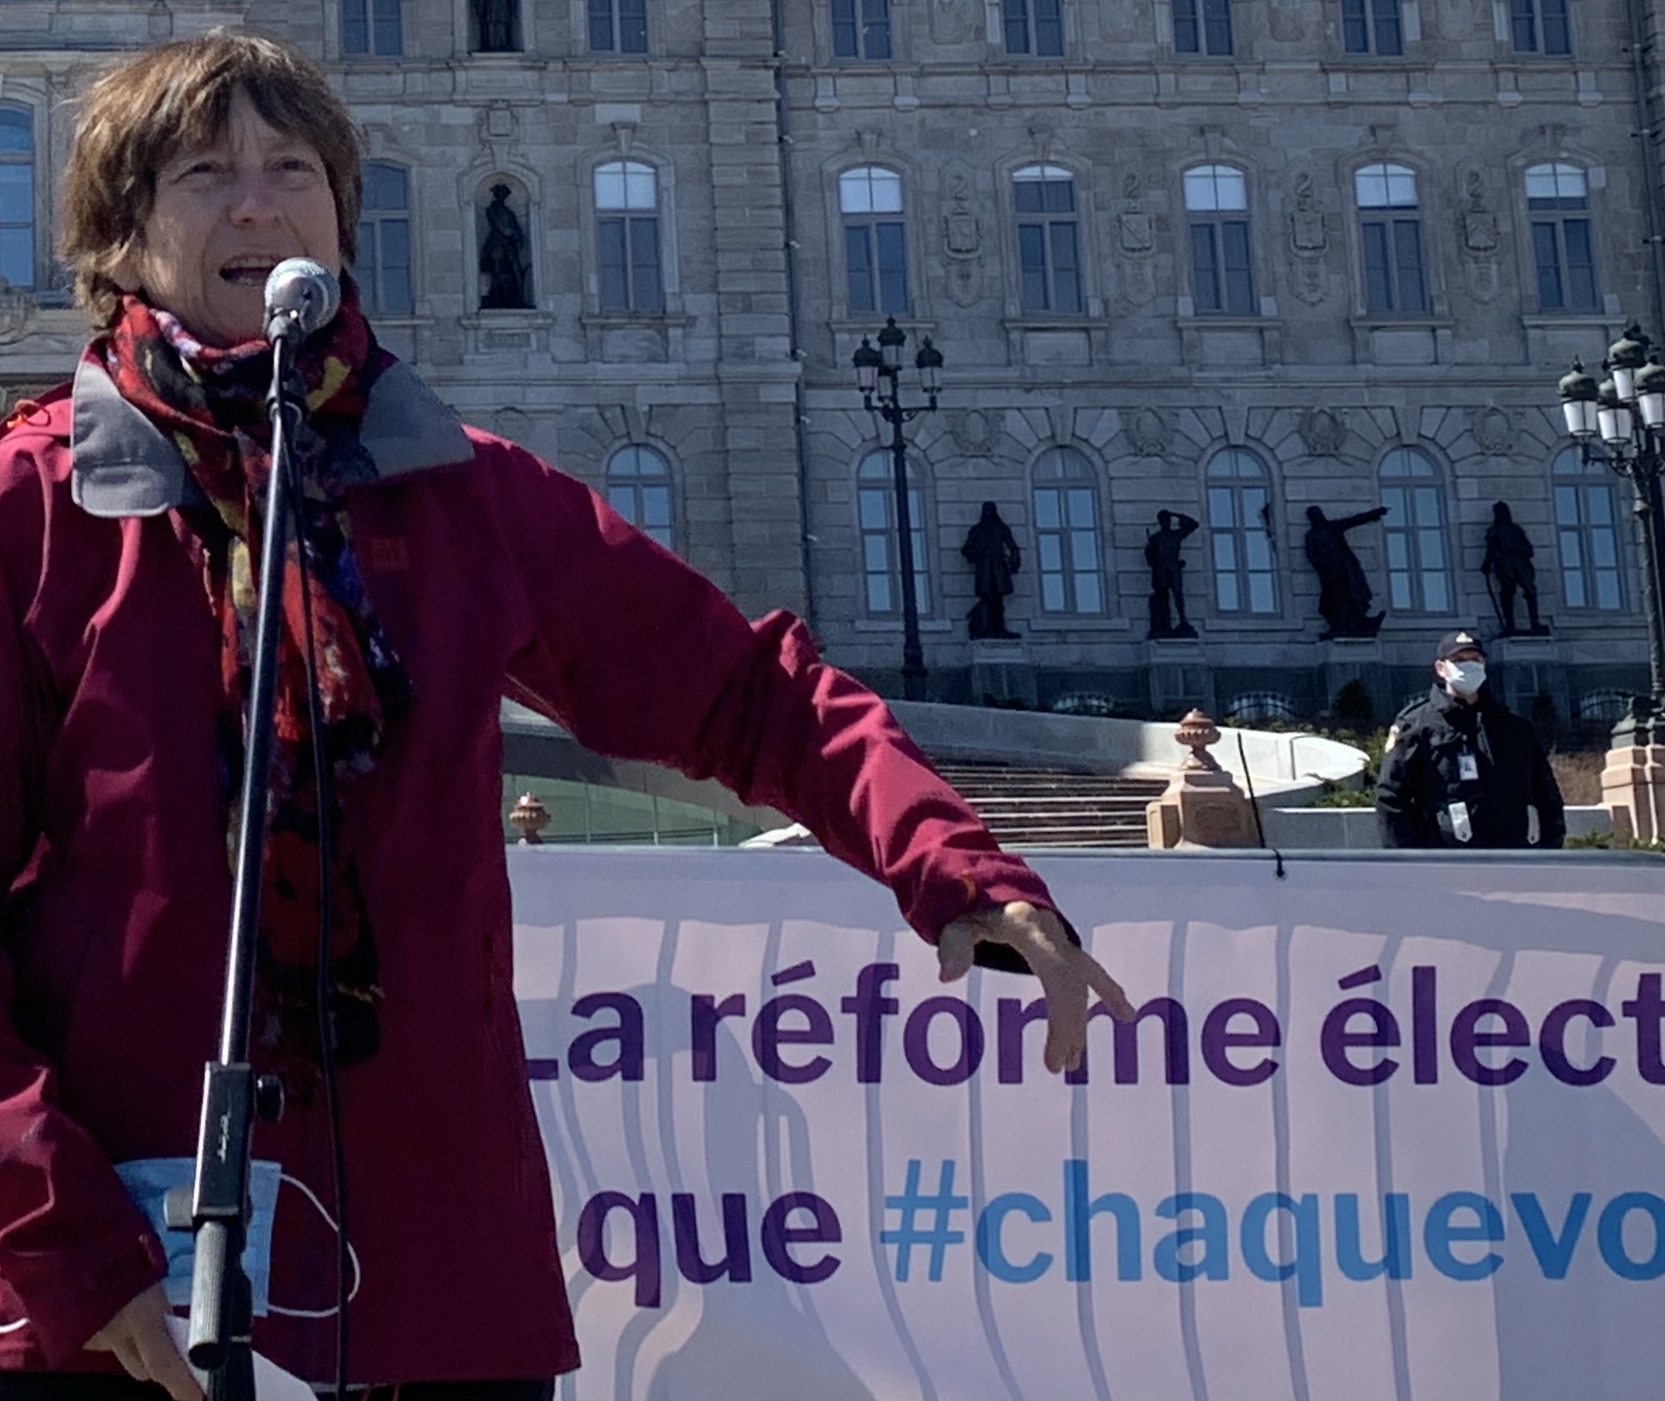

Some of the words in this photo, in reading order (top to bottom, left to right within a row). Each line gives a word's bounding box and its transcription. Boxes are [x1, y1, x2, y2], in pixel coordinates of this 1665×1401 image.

[690, 960, 1283, 1087] réforme
[1320, 964, 1665, 1088] élect
[576, 1190, 843, 1308] que
[880, 1159, 1665, 1308] #chaquevo
